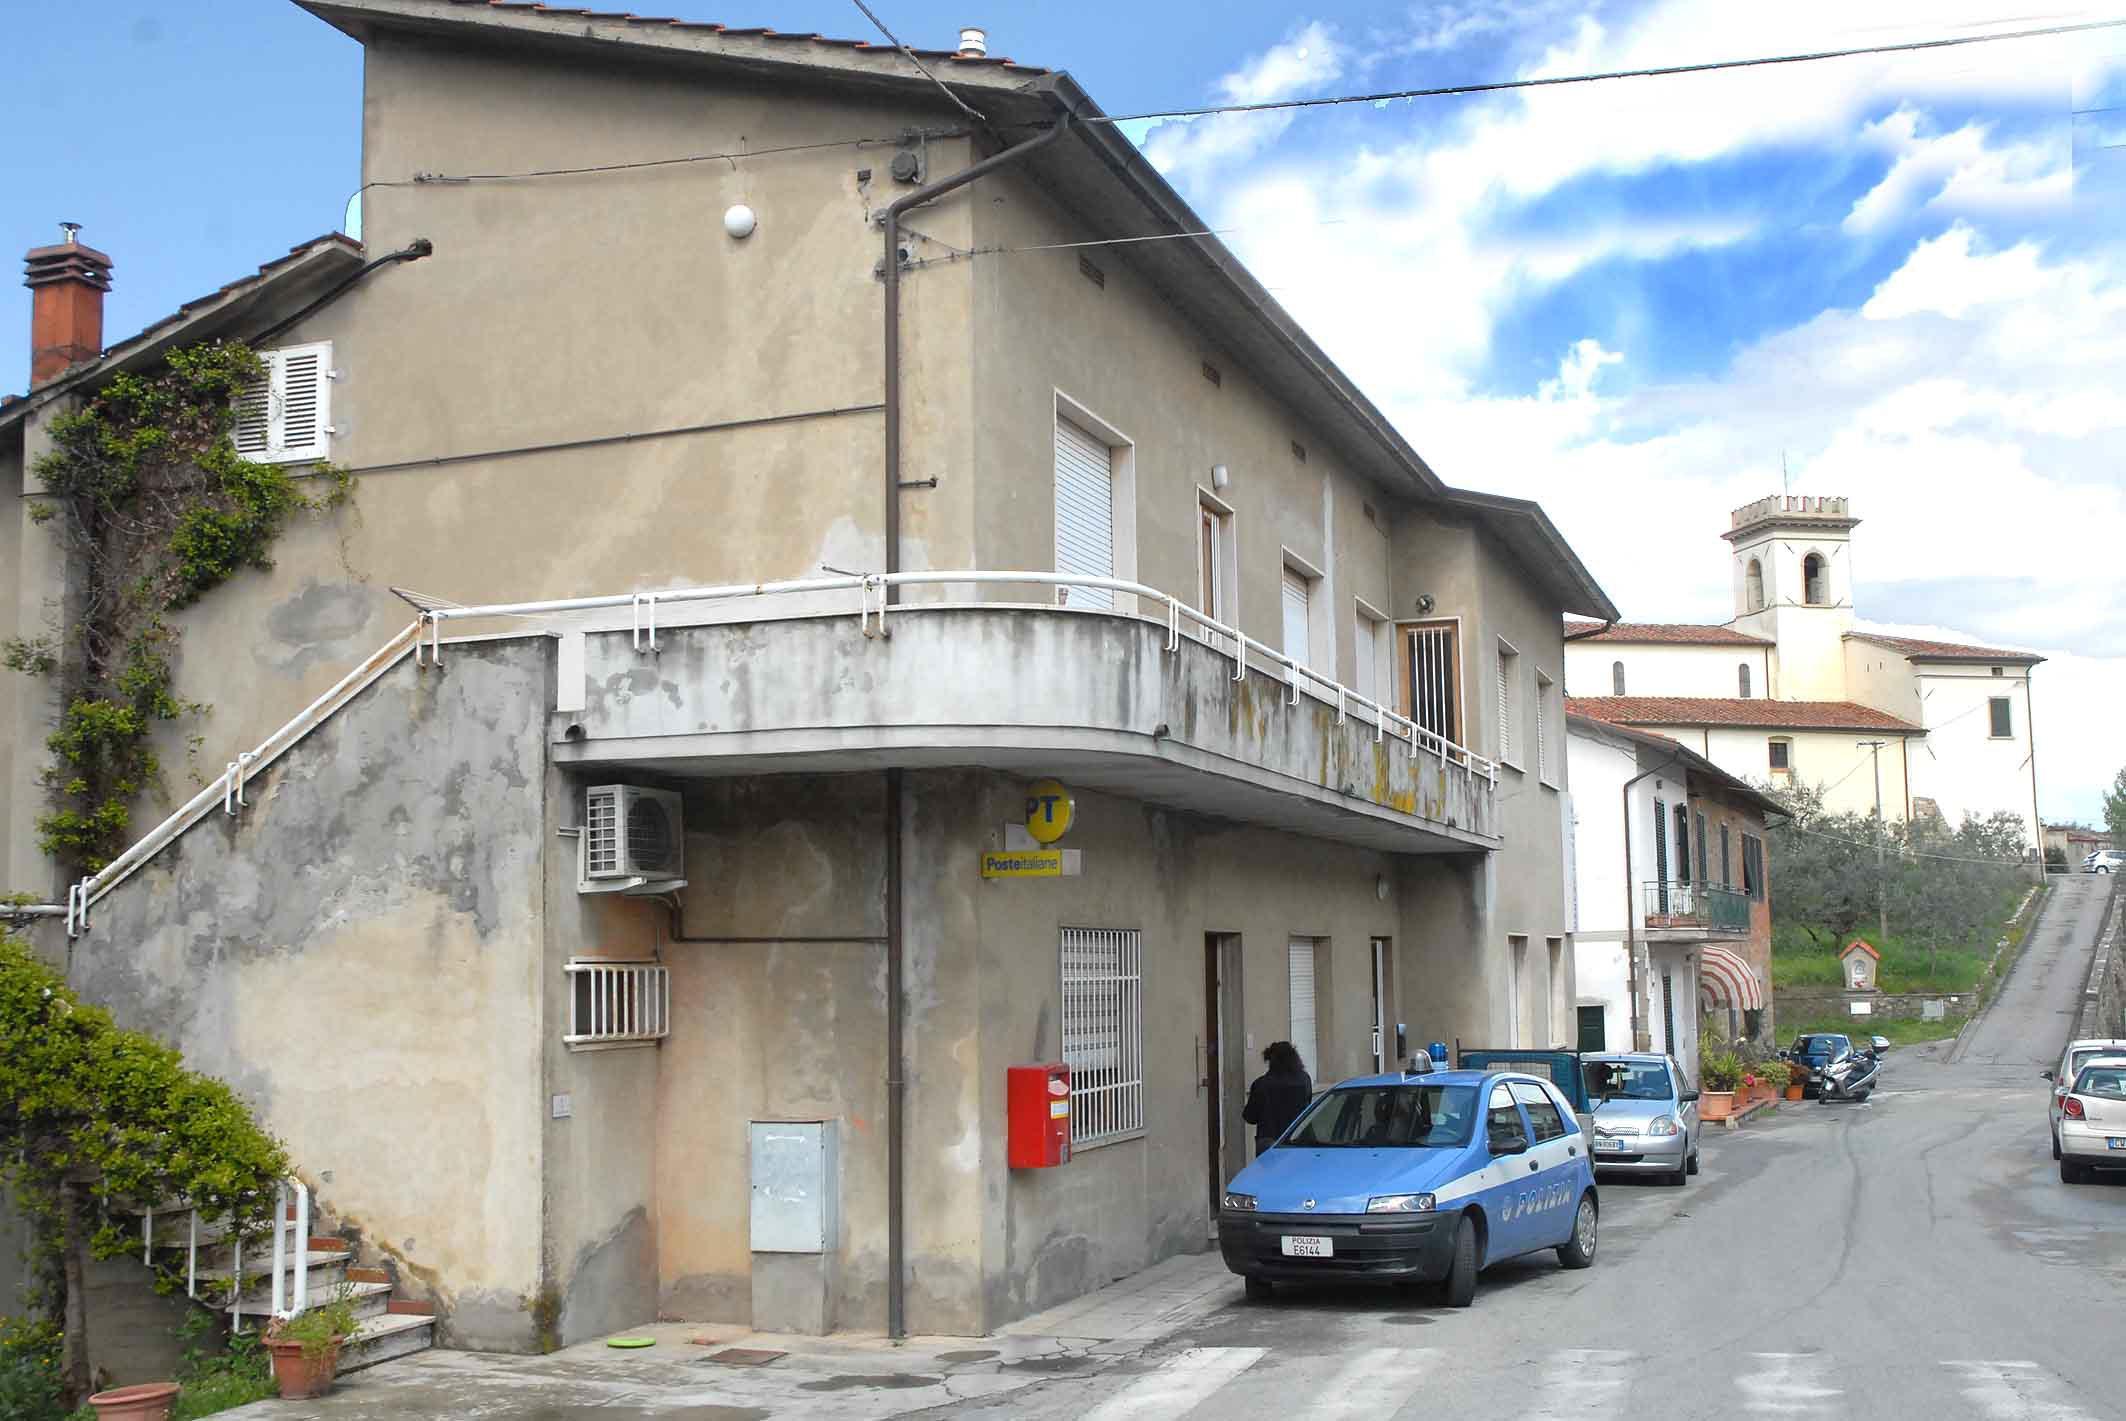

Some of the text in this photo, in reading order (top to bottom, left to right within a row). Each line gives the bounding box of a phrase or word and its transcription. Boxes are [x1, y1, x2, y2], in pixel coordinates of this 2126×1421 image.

[1516, 1180, 1571, 1218] POLIZIA
[1292, 1237, 1321, 1245] POLIZIA
[1293, 1245, 1320, 1256] E6144
